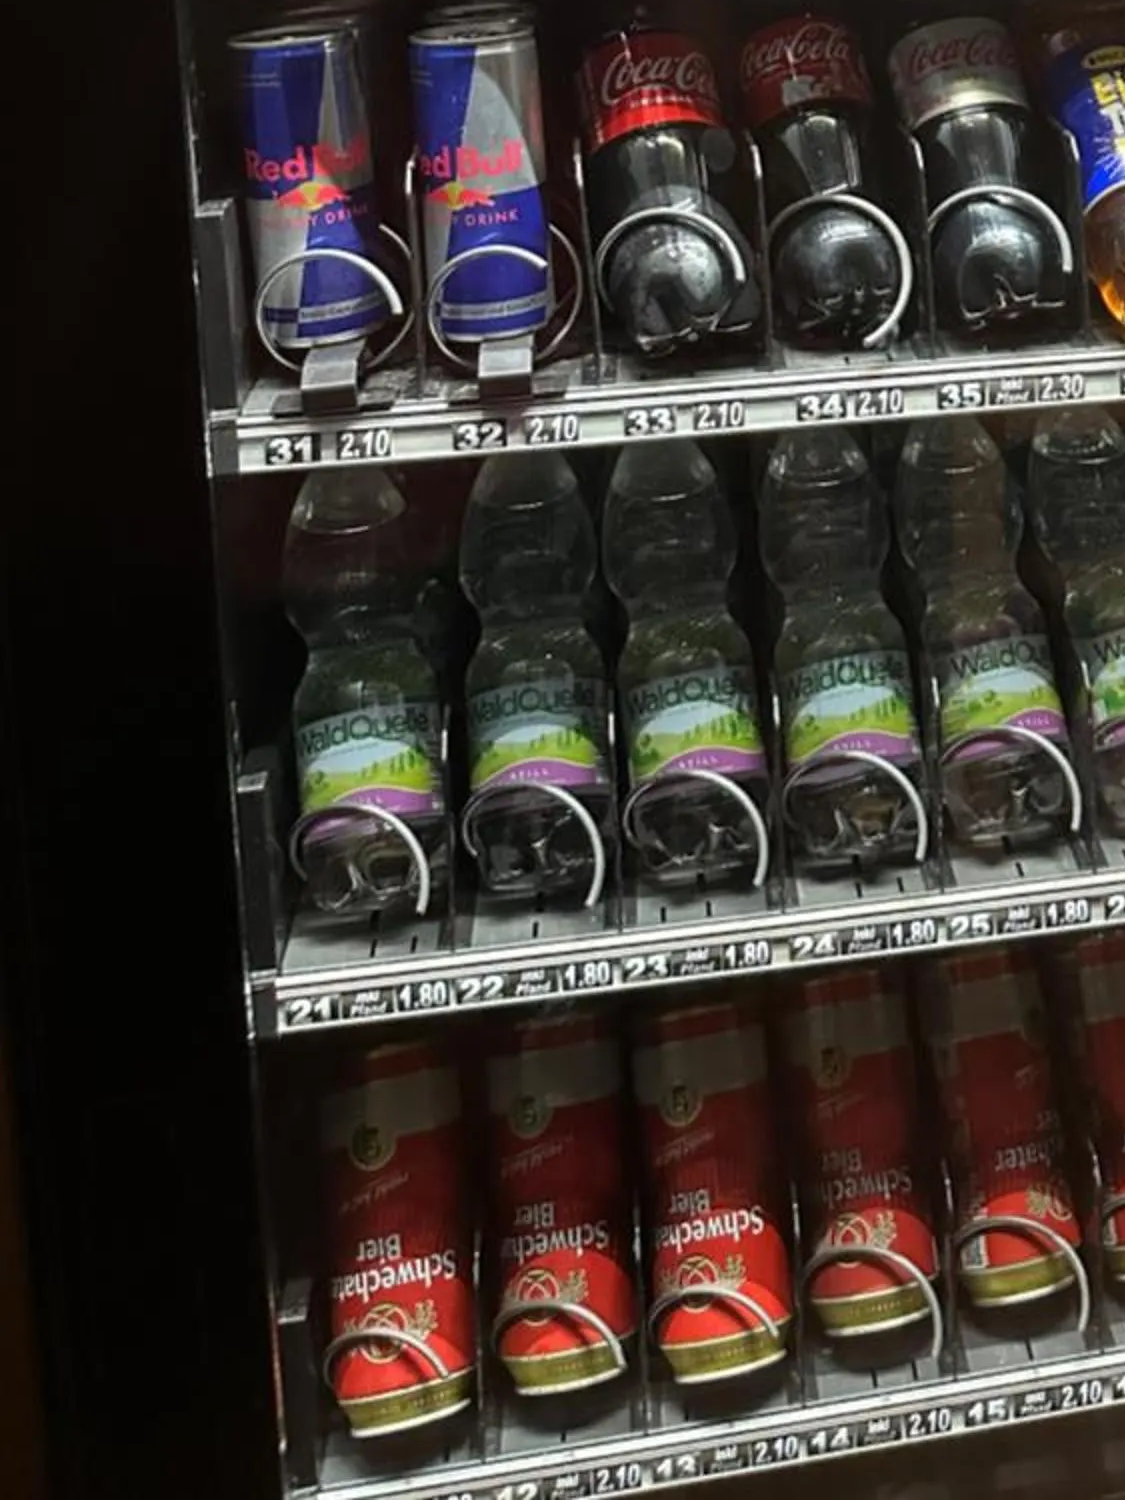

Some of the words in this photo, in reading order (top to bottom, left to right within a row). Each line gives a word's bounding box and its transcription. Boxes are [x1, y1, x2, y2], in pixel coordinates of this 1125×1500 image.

[244, 145, 307, 183] Red
[415, 144, 451, 180] ed
[457, 139, 524, 180] Bull
[464, 208, 520, 227] DRINK
[800, 393, 846, 421] 34
[856, 389, 902, 416] 2.10
[940, 383, 984, 409] 35
[1038, 374, 1084, 401] 2.30
[455, 422, 503, 450] 32
[527, 415, 578, 443] 2.10
[626, 407, 675, 435] 33
[697, 401, 744, 429] 2.10
[268, 437, 313, 464] 31
[340, 430, 391, 459] 2.10
[951, 912, 992, 939] 25
[1046, 899, 1091, 926] 1.80
[792, 932, 836, 960] 24
[891, 918, 936, 946] 1.80
[623, 954, 668, 981] 23
[725, 940, 769, 968] 1.80
[460, 975, 504, 1002] 22
[564, 961, 611, 989] 1.80
[287, 997, 332, 1025] 21
[400, 981, 446, 1009] 1.80
[514, 1202, 555, 1229] Bier
[668, 1187, 711, 1214] Bier
[355, 1233, 401, 1262] Bier
[966, 1397, 1007, 1425] 15
[1061, 1379, 1103, 1408] 2.10
[810, 1425, 850, 1454] 14
[908, 1408, 951, 1436] 2.10
[655, 1452, 698, 1481] 13
[754, 1434, 798, 1463] 2.10
[597, 1462, 641, 1492] 2.10
